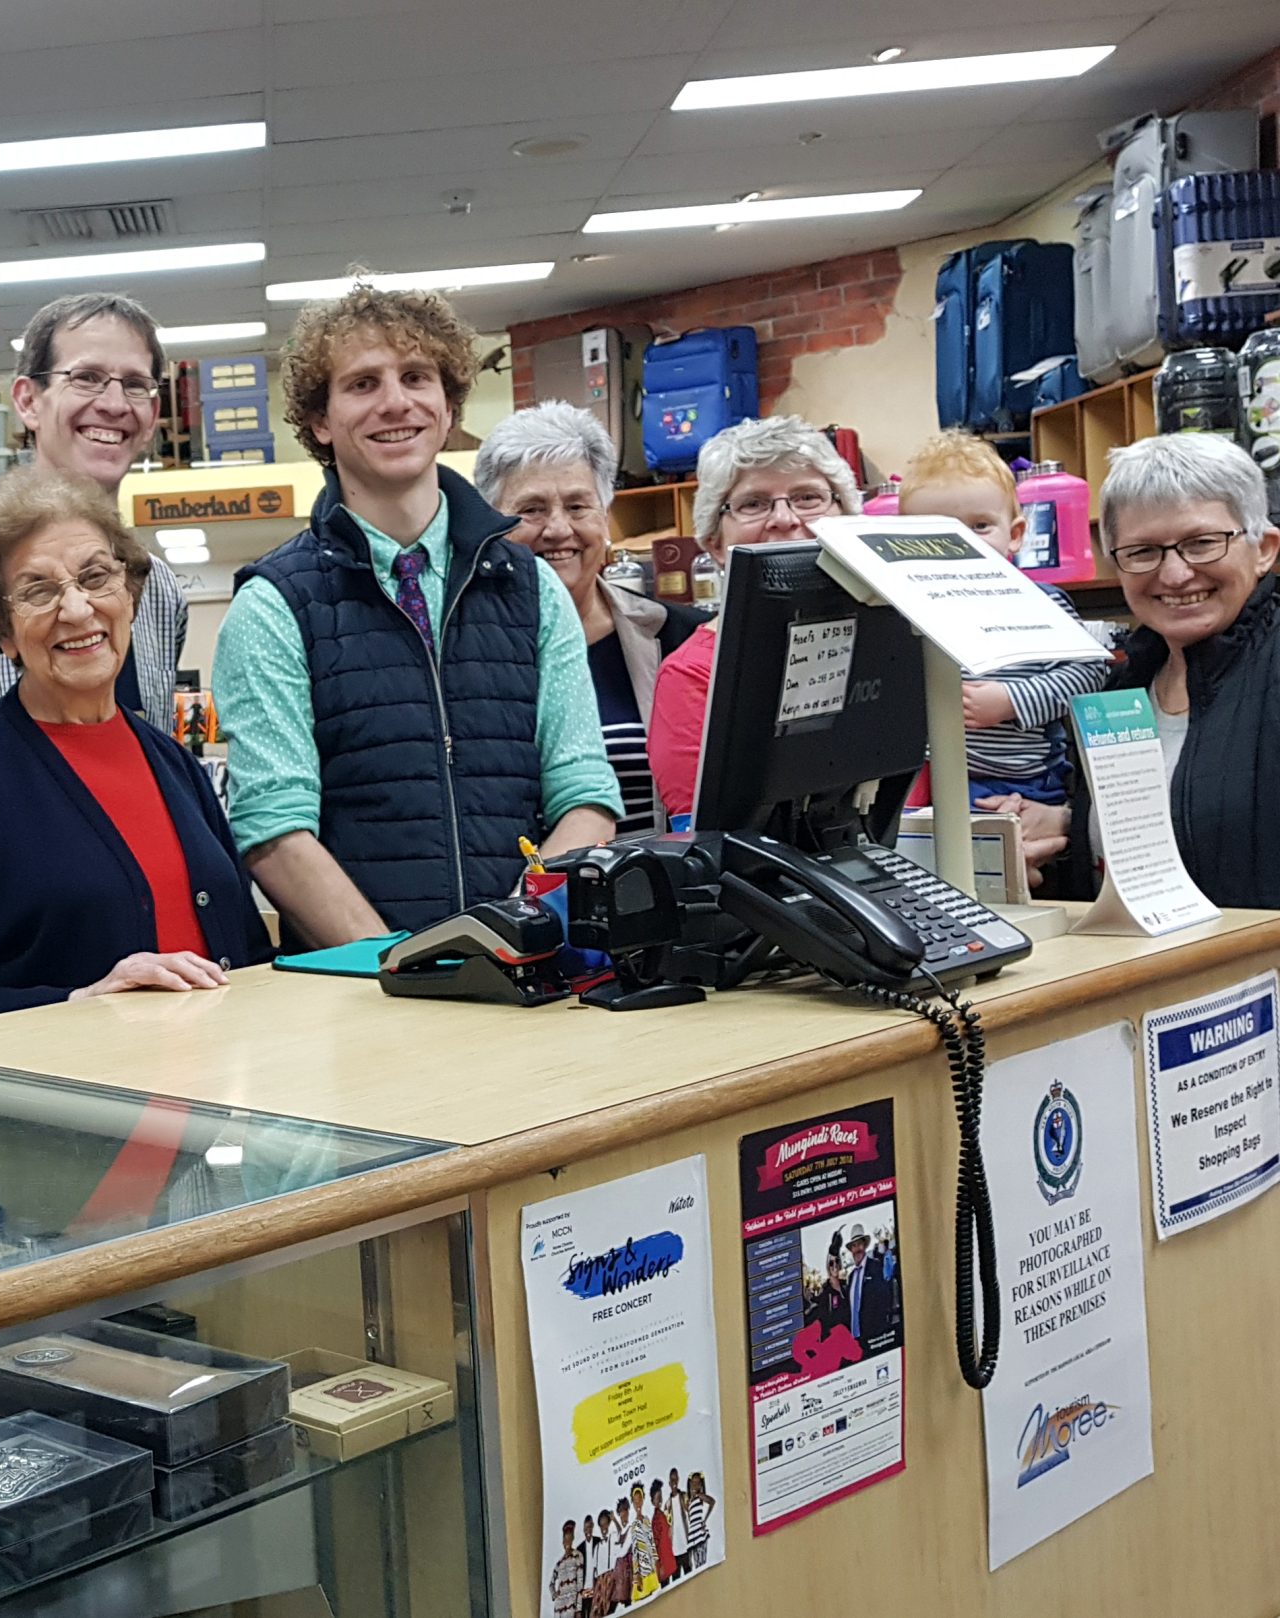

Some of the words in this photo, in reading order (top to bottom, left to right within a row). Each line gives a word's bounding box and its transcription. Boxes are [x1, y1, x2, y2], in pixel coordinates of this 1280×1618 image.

[144, 492, 251, 520] Timberland
[1086, 729, 1117, 746] Refunds
[1117, 726, 1131, 743] and
[1131, 726, 1155, 741] returns
[1189, 1012, 1254, 1054] WARNING
[1177, 1078, 1189, 1092] AS
[1190, 1076, 1197, 1088] A
[1198, 1060, 1238, 1086] CONDITION
[1239, 1057, 1247, 1070] OF
[1247, 1048, 1266, 1066] ENTRY
[1171, 1111, 1188, 1129] We
[1190, 1096, 1229, 1123] Reserve
[1230, 1088, 1245, 1107] the
[1245, 1081, 1265, 1104] Right
[1265, 1076, 1273, 1089] to
[775, 1126, 829, 1168] Mungindi
[829, 1124, 859, 1145] Races
[1214, 1114, 1247, 1139] Inspect
[1198, 1143, 1241, 1171] Shopping
[1242, 1132, 1261, 1153] Bags
[784, 1164, 814, 1182] SATURDAY
[526, 1218, 542, 1230] Proudly
[542, 1213, 564, 1226] supported
[668, 1195, 695, 1214] Watoto
[551, 1225, 573, 1240] MCCN
[1028, 1225, 1052, 1247] YOU
[1054, 1213, 1077, 1238] MAY
[1078, 1207, 1092, 1227] BE
[563, 1247, 621, 1290] Signs
[624, 1236, 637, 1264] &
[1019, 1225, 1103, 1276] PHOTOGRAPHED
[602, 1254, 677, 1297] Wonders
[1011, 1280, 1035, 1303] FOR
[1036, 1243, 1111, 1292] SURVEILLANCE
[592, 1307, 614, 1323] FREE
[615, 1293, 653, 1315] CONCERT
[1014, 1290, 1062, 1326] REASONS
[1063, 1273, 1097, 1301] WHILE
[1097, 1265, 1112, 1285] ON
[1023, 1315, 1058, 1344] THESE
[1058, 1291, 1107, 1328] PREMISES
[561, 1364, 572, 1374] THE
[572, 1355, 591, 1369] SOUND
[592, 1351, 600, 1360] OF
[607, 1334, 649, 1353] TRANSFORMED
[650, 1320, 685, 1338] GENERATION
[620, 1353, 647, 1368] UGANDA
[633, 1383, 644, 1393] July
[1055, 1393, 1091, 1422] Tourism
[608, 1413, 622, 1424] Moree
[622, 1408, 637, 1417] Town
[637, 1402, 648, 1412] Hall
[588, 1446, 600, 1457] Light
[634, 1423, 645, 1433] after
[646, 1418, 654, 1428] the
[1017, 1401, 1108, 1473] Moree
